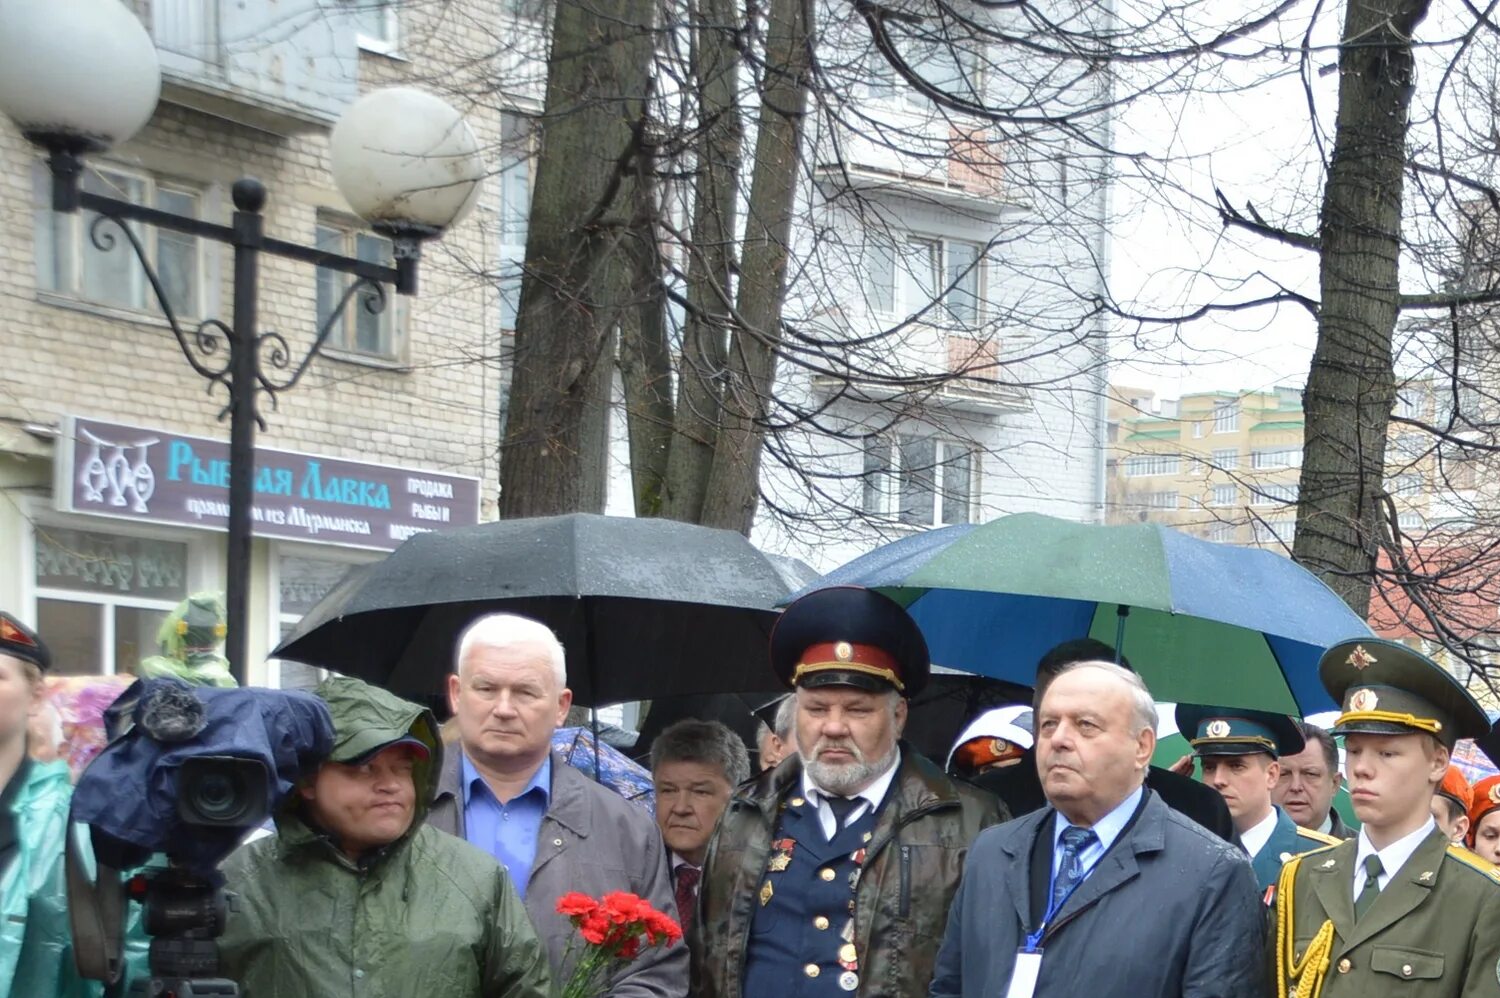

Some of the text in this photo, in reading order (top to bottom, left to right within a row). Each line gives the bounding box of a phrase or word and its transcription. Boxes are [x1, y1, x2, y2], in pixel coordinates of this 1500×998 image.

[407, 477, 454, 499] ПРОДАЖА
[265, 506, 285, 525] из
[286, 505, 371, 535] Мурманска
[412, 502, 441, 521] РЫБЫ
